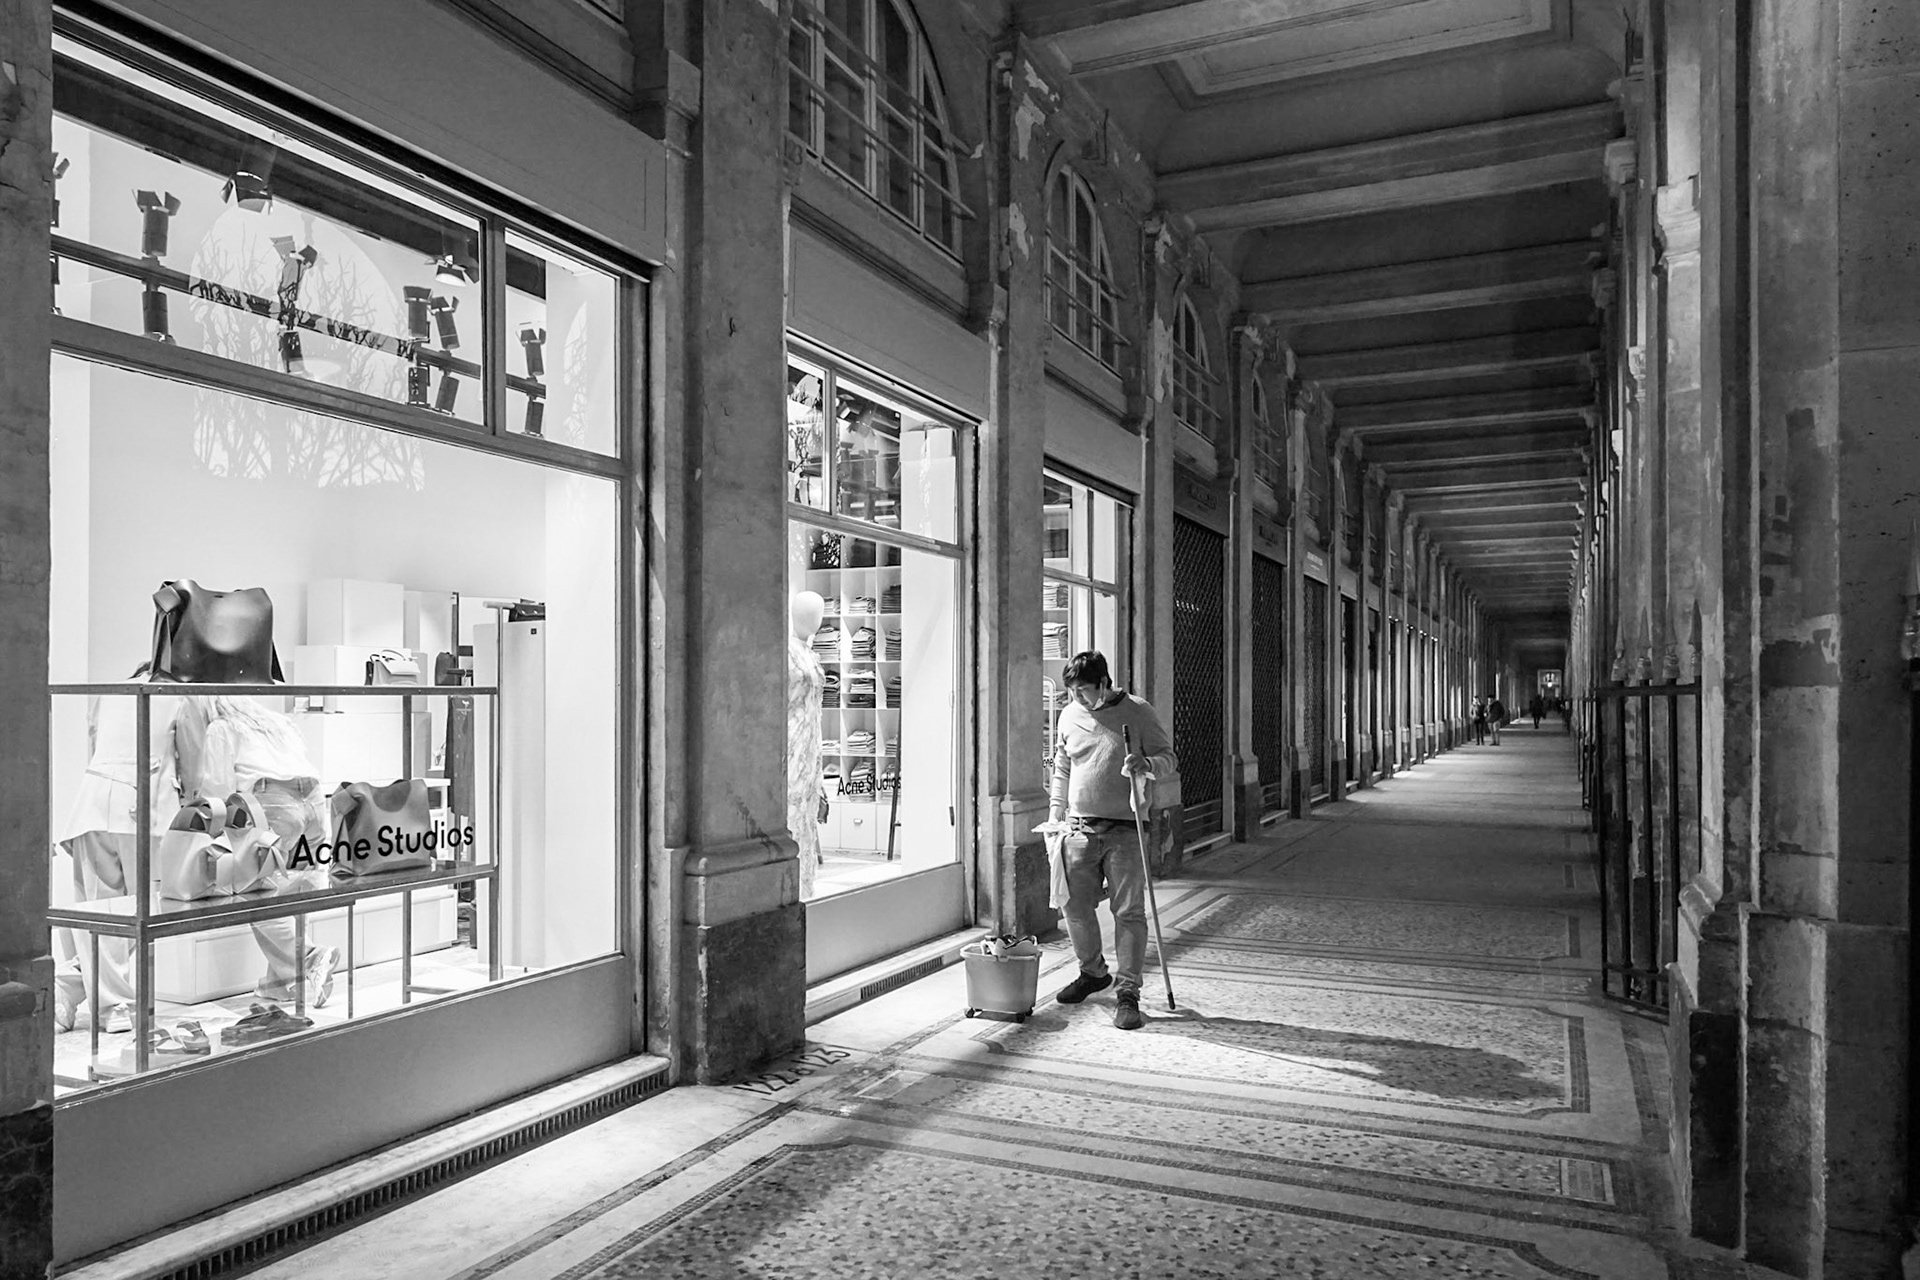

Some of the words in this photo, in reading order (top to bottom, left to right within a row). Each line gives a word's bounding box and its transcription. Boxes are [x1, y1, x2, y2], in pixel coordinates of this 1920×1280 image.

[837, 776, 865, 796] Acne
[867, 772, 902, 793] Studios
[290, 834, 371, 869] Acne
[377, 820, 474, 857] Studios
[732, 1073, 801, 1096] 122
[791, 1047, 852, 1068] 123
